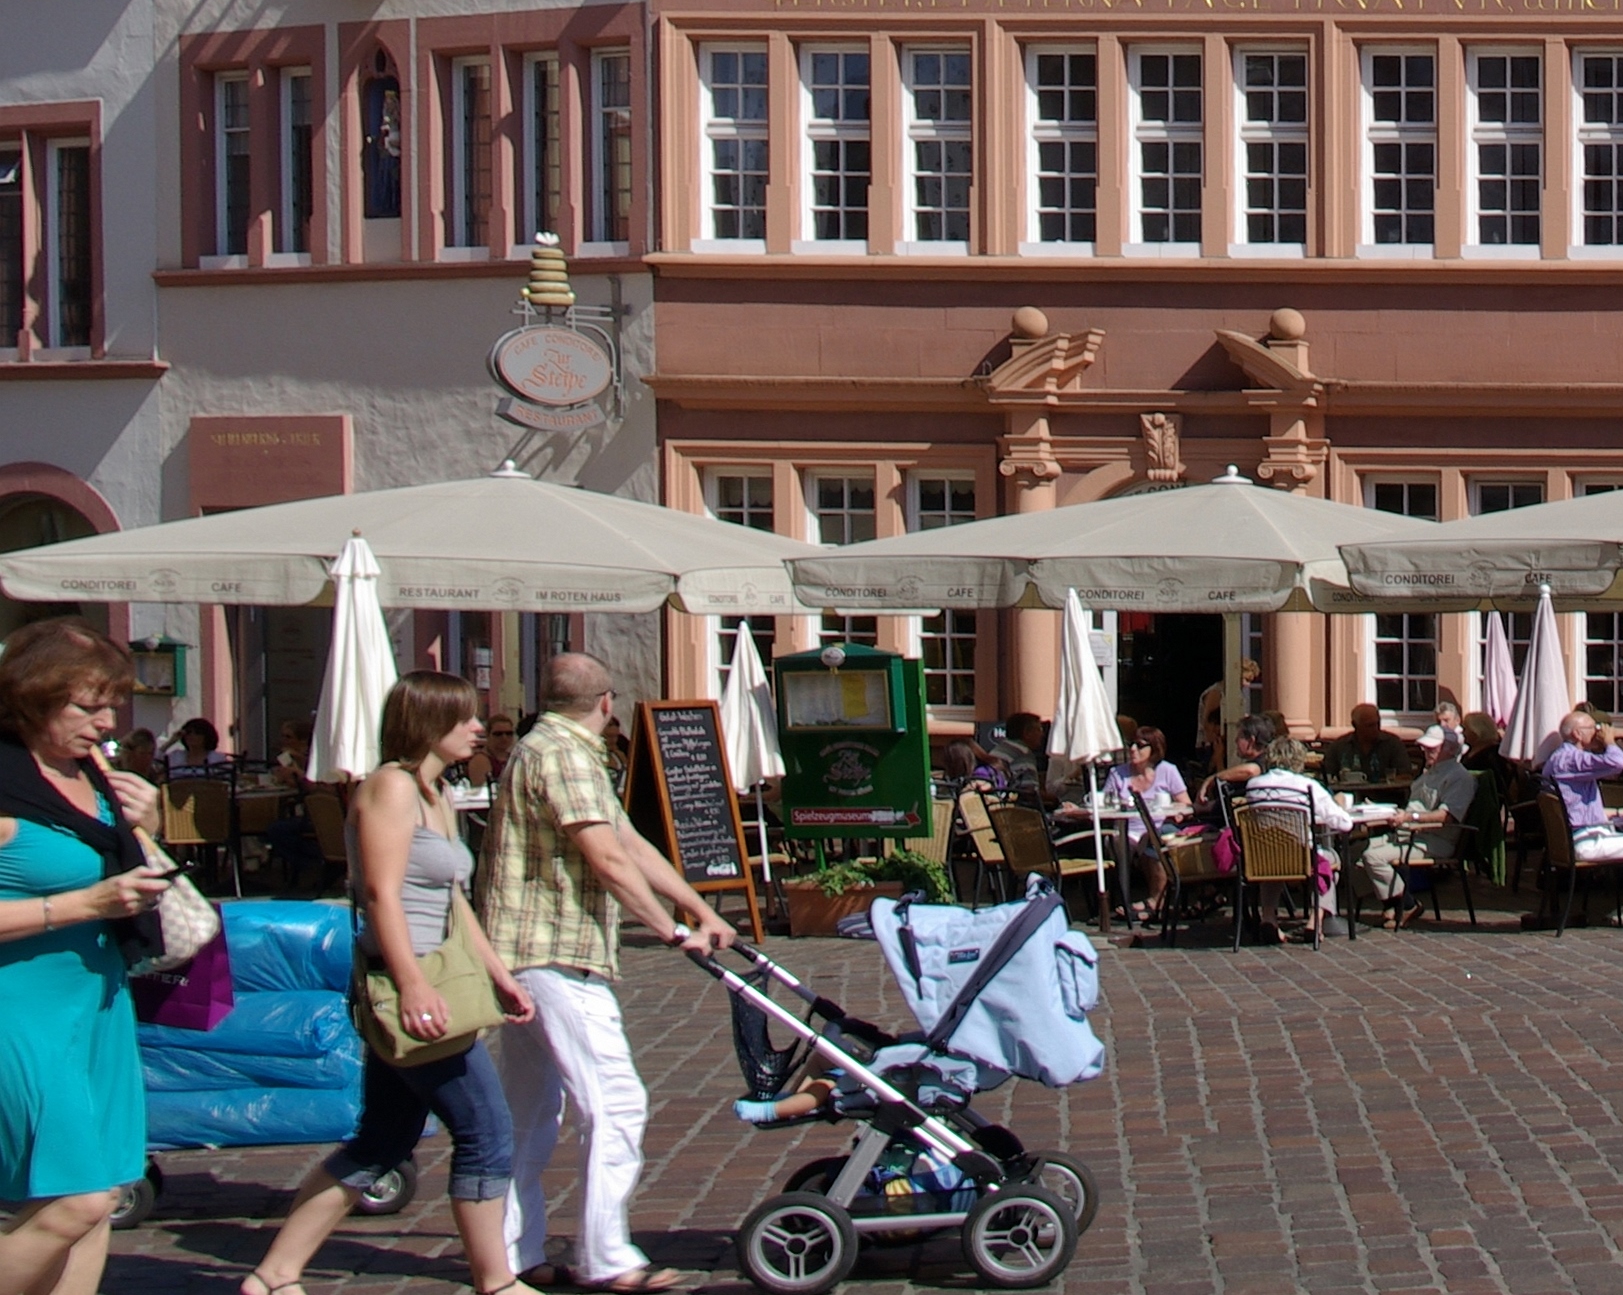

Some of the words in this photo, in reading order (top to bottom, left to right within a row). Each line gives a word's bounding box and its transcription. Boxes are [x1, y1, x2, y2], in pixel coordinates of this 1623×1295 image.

[515, 404, 598, 427] RESTAURANT
[1385, 573, 1455, 585] CONDITOREI
[1524, 573, 1553, 584] CAFE
[60, 579, 138, 591] CONDITOREI
[211, 582, 243, 594] CAFE
[400, 587, 480, 600] RESTAURANT
[535, 590, 552, 601] IM
[553, 590, 588, 602] ROTEN
[590, 591, 622, 603] HAUS
[825, 587, 888, 598] CONDITOREI
[947, 588, 974, 598] CAFE
[1078, 588, 1145, 600] CONDITOREI
[1207, 589, 1236, 601] CAFE
